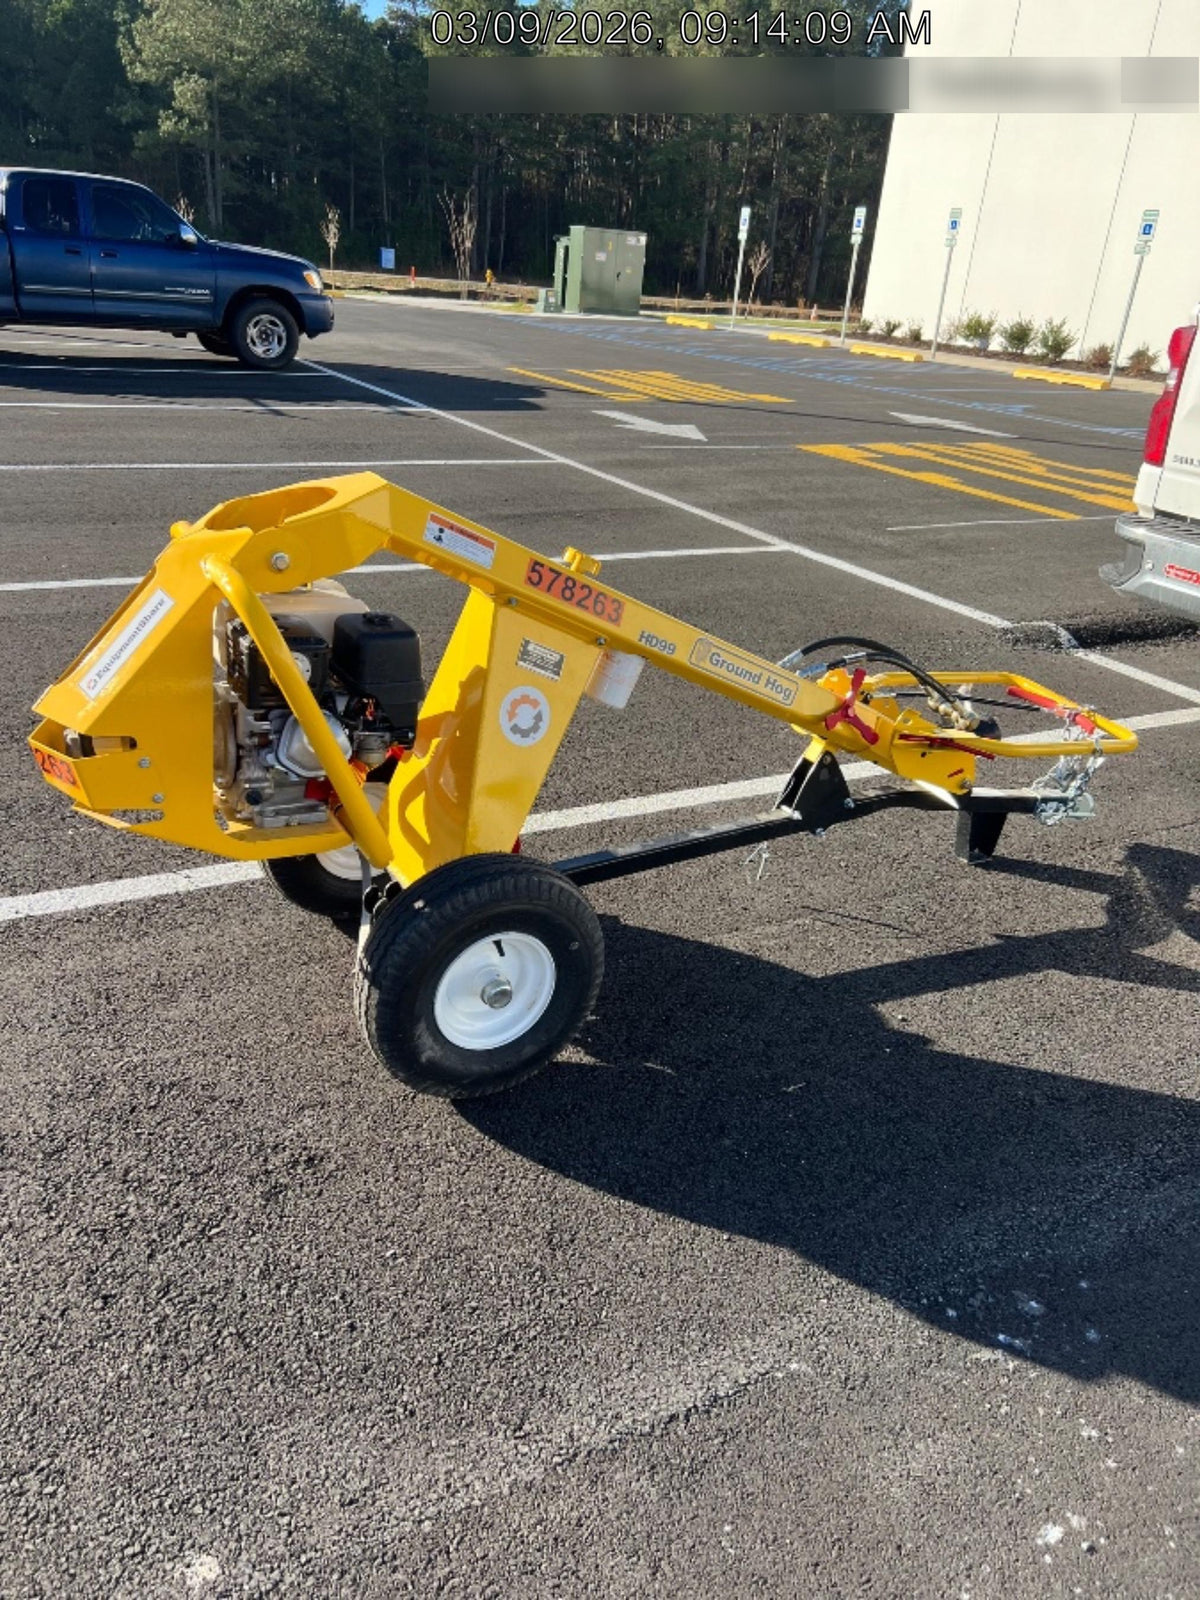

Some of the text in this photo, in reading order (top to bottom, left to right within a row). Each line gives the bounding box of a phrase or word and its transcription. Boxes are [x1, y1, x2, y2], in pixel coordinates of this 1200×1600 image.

[527, 559, 623, 624] 578263
[638, 630, 677, 655] HD99
[708, 651, 794, 701] Ground Hog
